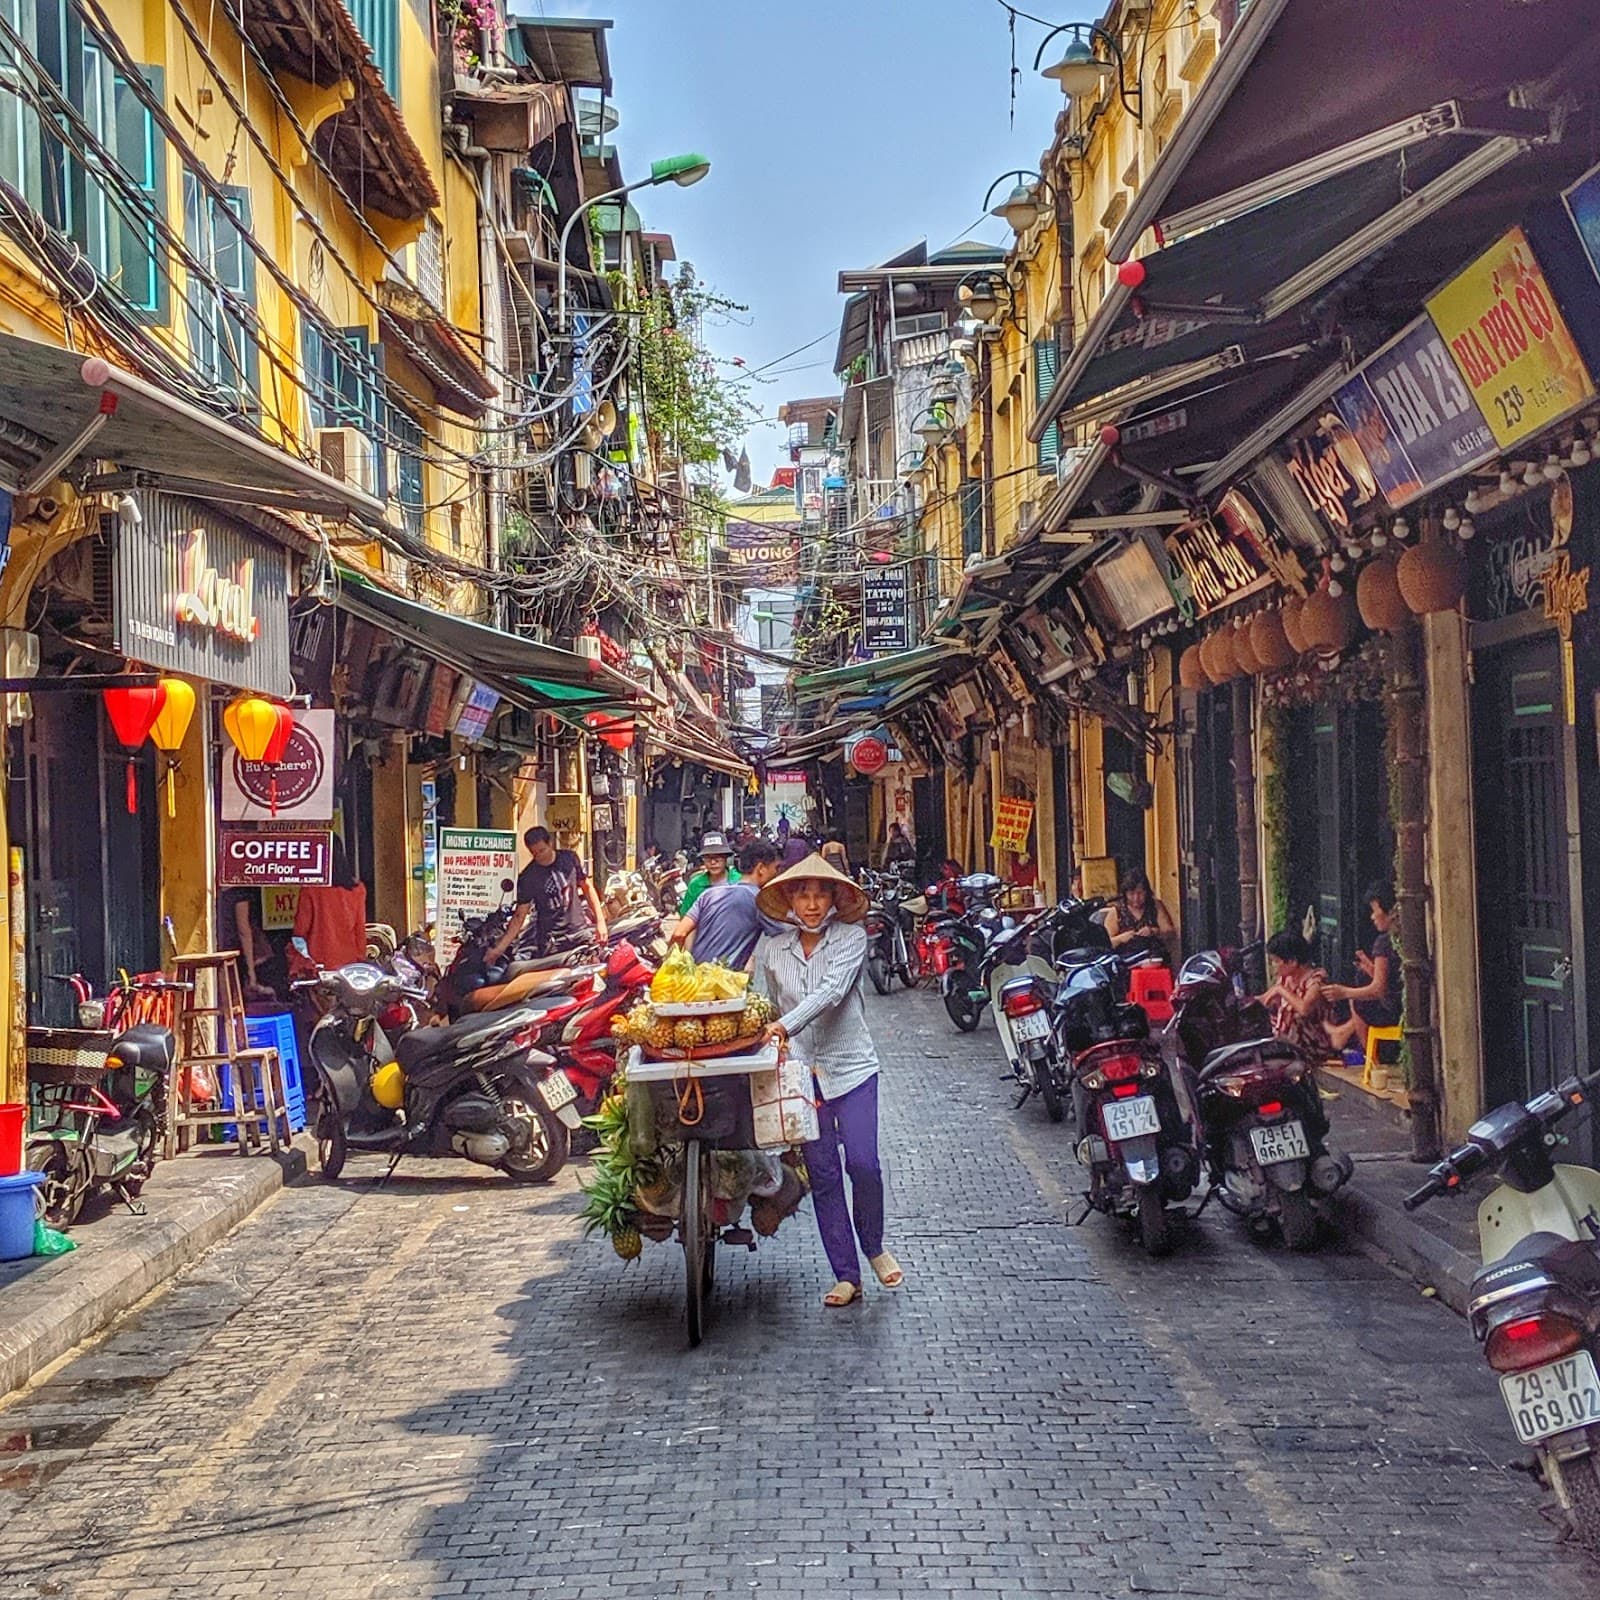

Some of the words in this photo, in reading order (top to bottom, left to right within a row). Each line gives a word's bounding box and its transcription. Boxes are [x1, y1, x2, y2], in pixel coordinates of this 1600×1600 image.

[1452, 327, 1498, 389] BIA
[1479, 271, 1530, 368] PHỐ
[1514, 246, 1554, 341] CỔ
[1375, 361, 1442, 446] BIA
[1415, 338, 1471, 420] 23
[1286, 437, 1352, 527] Tiger
[866, 588, 904, 601] TATTOO
[230, 840, 311, 859] COFFEE
[445, 834, 473, 849] MONEY
[473, 836, 513, 850] EXCHANGE
[244, 862, 265, 875] 2nd
[267, 862, 296, 875] Floor
[455, 855, 491, 867] PROMOTION
[493, 853, 513, 869] 50%
[443, 868, 469, 876] HALONG
[1259, 1124, 1297, 1146] 29-E1
[1259, 1140, 1307, 1163] 966.12
[1485, 1262, 1535, 1283] HONDA
[1515, 1359, 1578, 1405] 29-V7
[1518, 1387, 1600, 1437] 069.02
